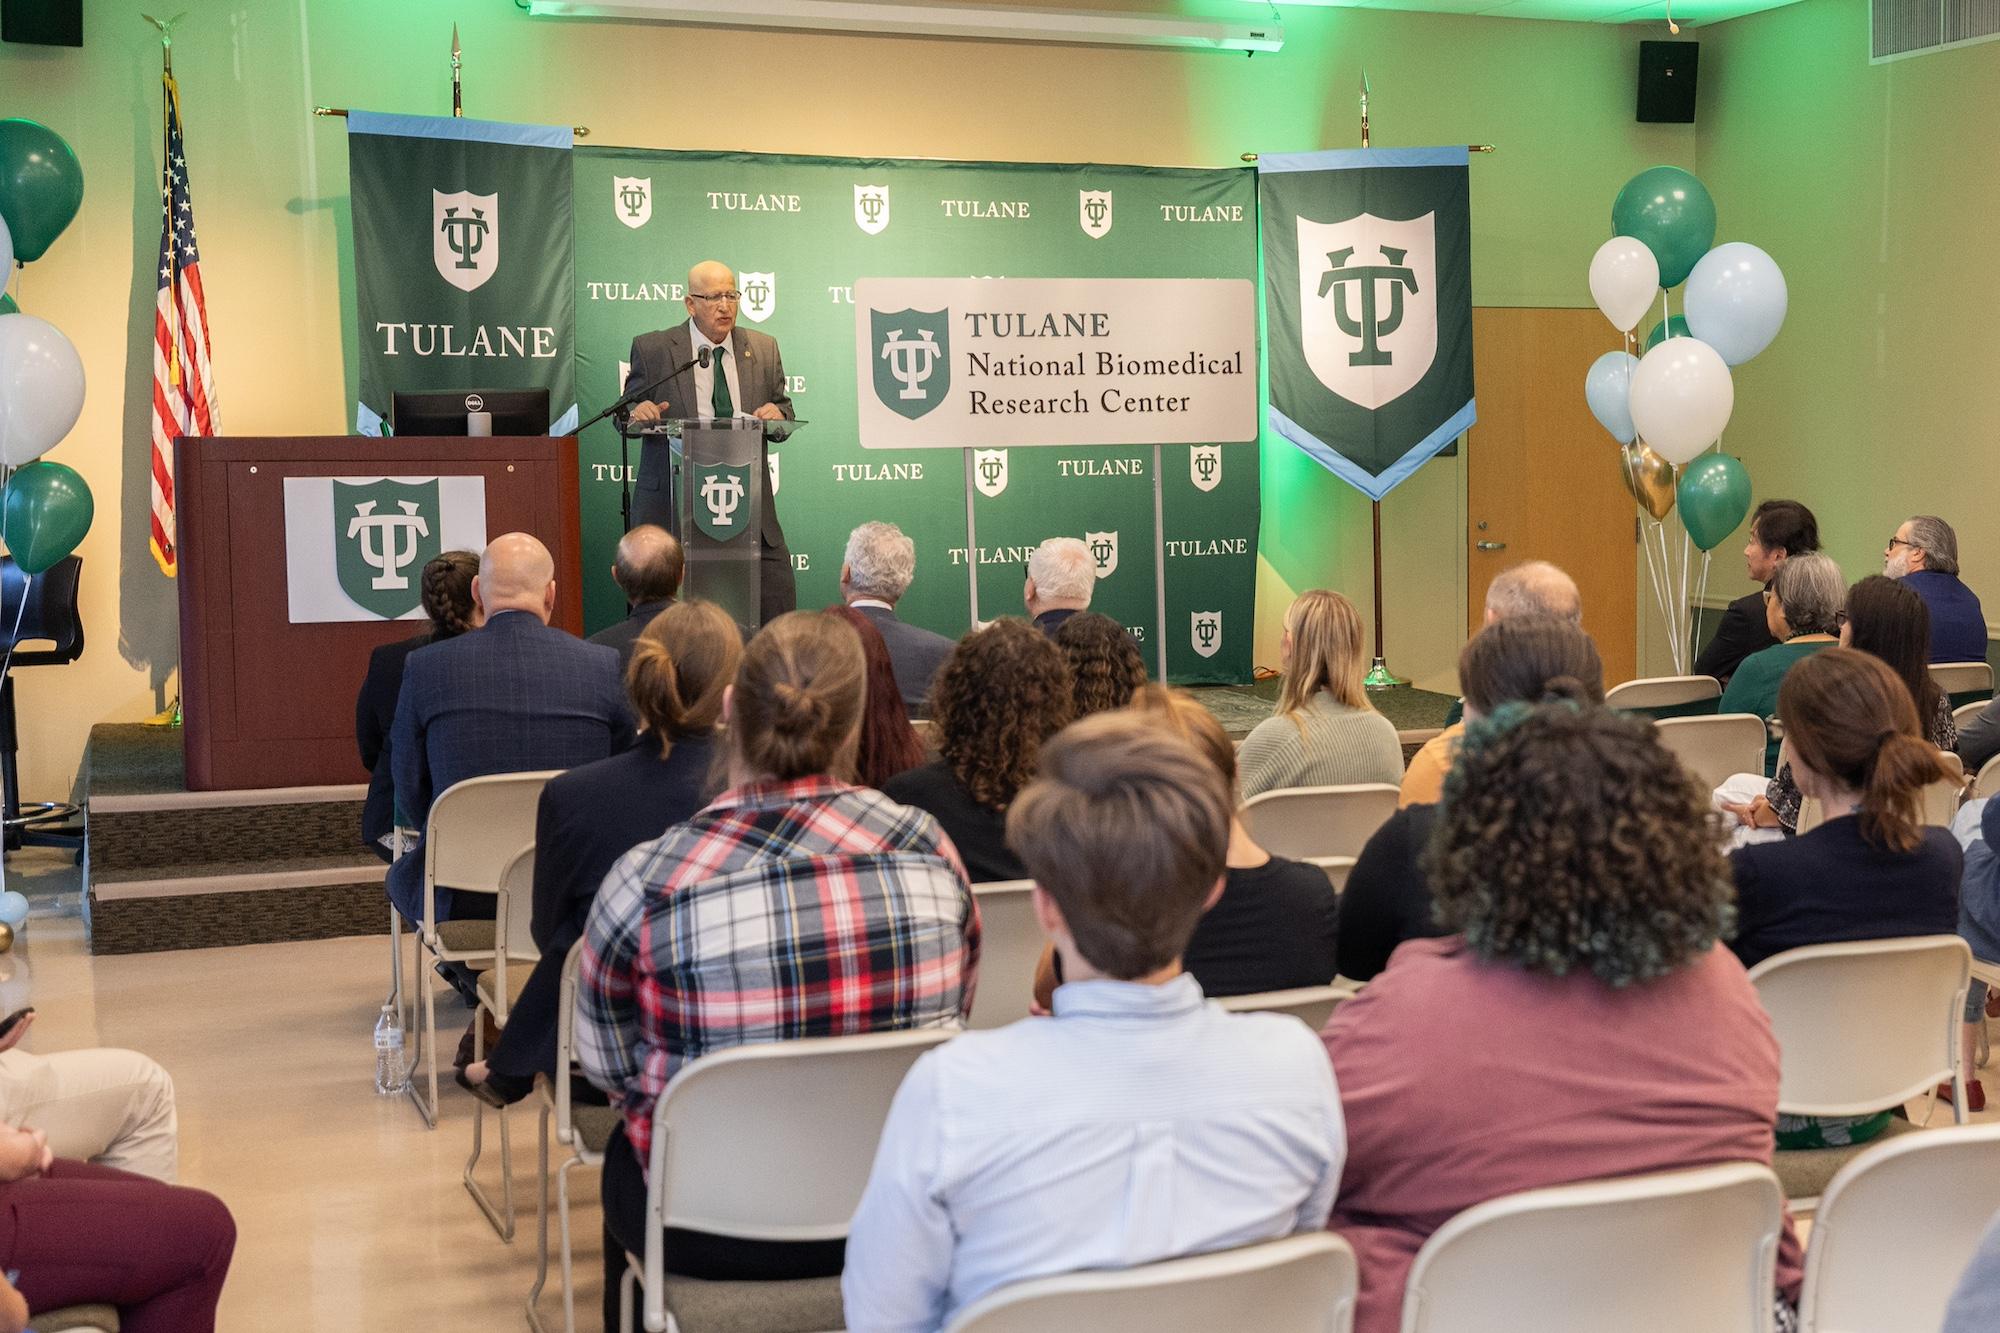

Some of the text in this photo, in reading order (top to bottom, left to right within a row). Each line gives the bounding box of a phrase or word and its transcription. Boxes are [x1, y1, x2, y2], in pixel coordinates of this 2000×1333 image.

[707, 192, 801, 213] TULANE
[941, 200, 1030, 218] TULANE
[1161, 206, 1243, 222] TULANE
[587, 282, 684, 301] TULANE
[965, 313, 1111, 338] TULANE
[376, 322, 557, 358] TULANE
[967, 351, 1243, 377] National Biomedical
[969, 389, 1190, 416] Research Center
[592, 464, 637, 482] TUL
[833, 463, 924, 481] TULANE
[1058, 459, 1143, 476] TULANE
[1166, 538, 1247, 556] TULANE
